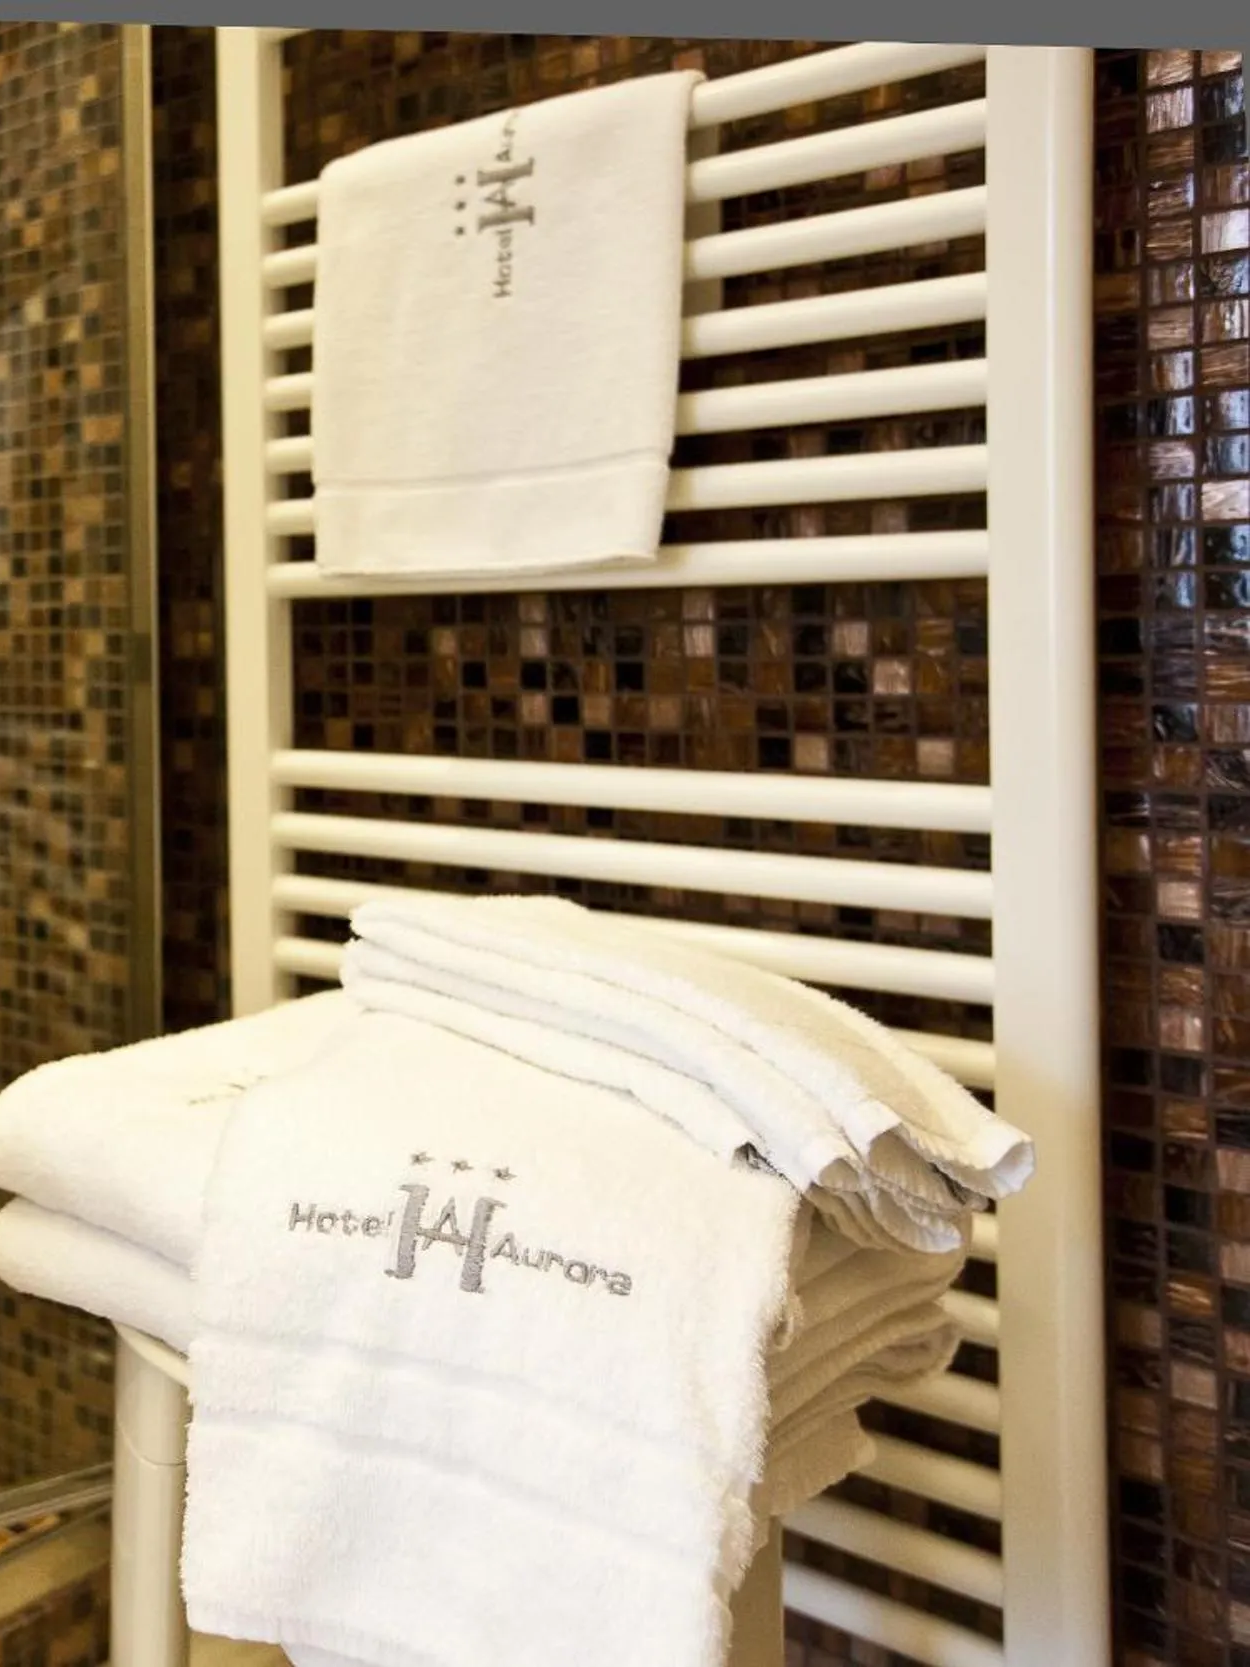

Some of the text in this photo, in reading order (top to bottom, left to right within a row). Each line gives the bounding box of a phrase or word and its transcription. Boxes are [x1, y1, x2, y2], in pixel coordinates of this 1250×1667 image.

[492, 229, 513, 298] Hotel
[288, 1201, 395, 1238] Hotel
[490, 1231, 634, 1297] Aurora
